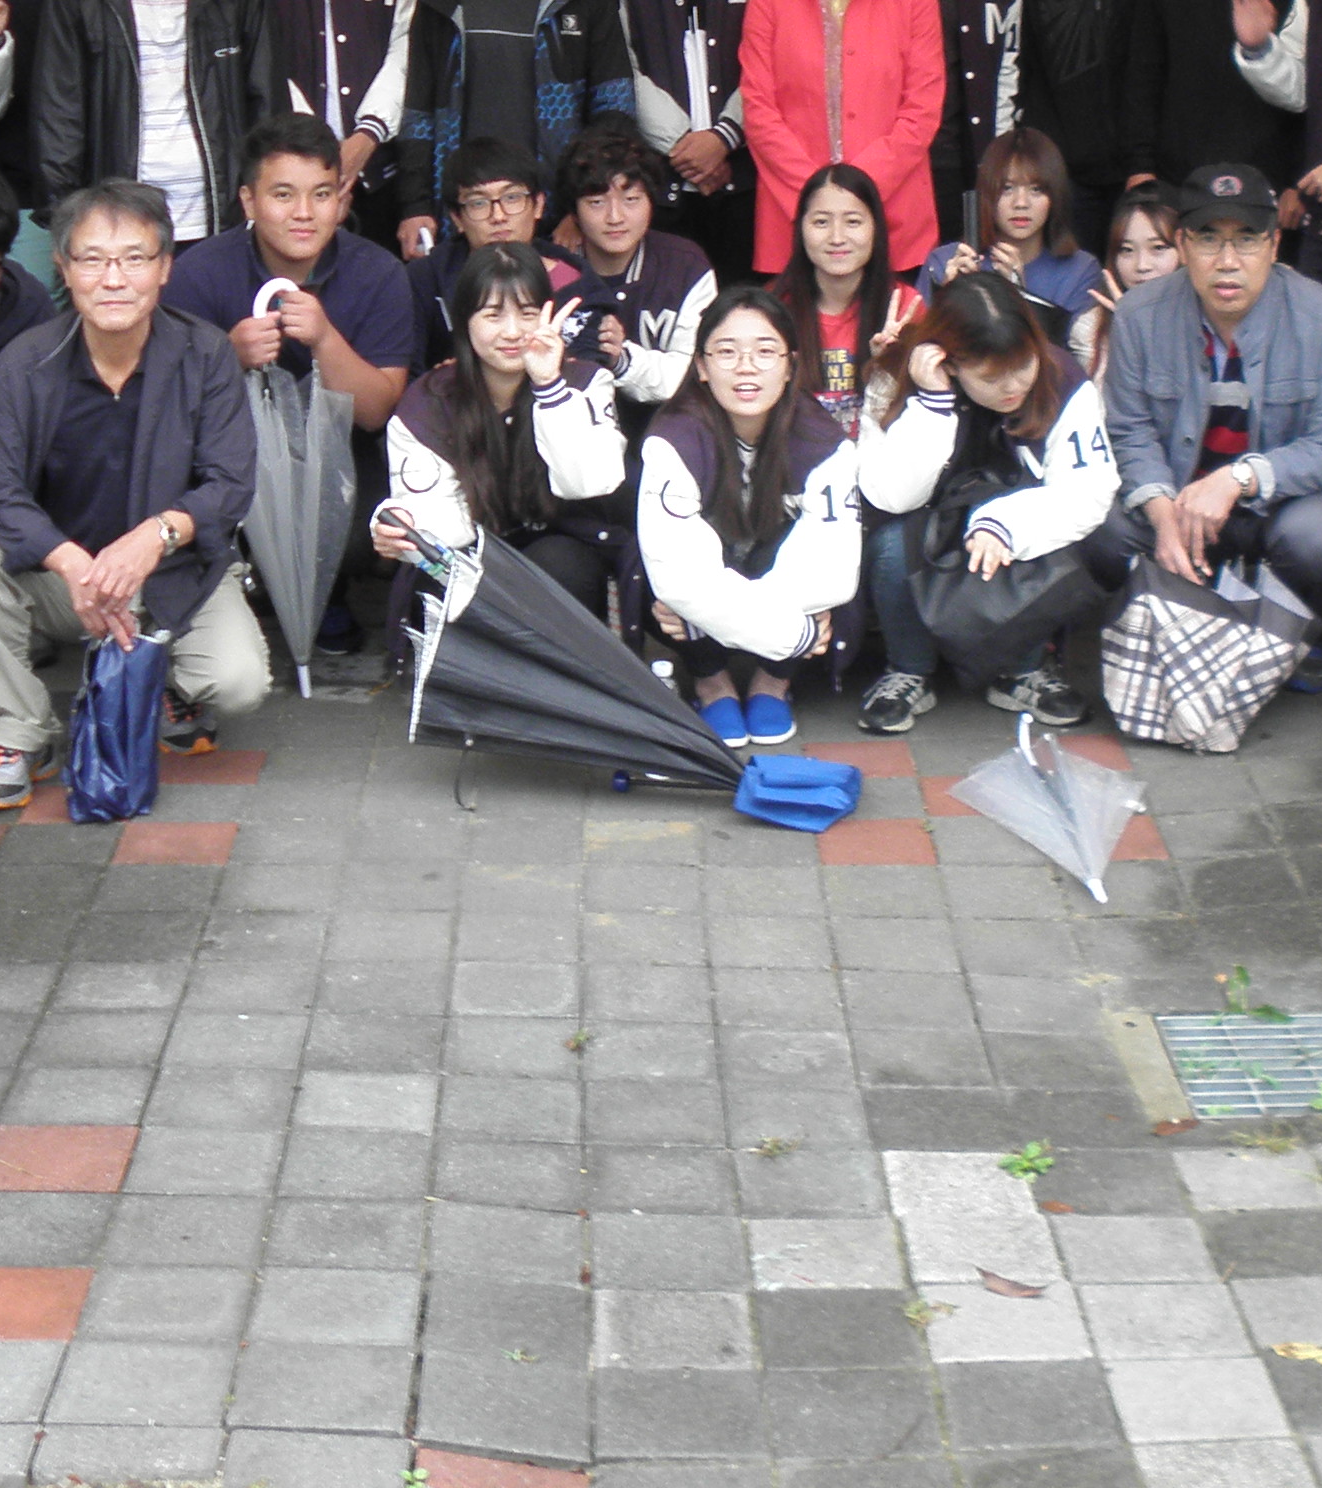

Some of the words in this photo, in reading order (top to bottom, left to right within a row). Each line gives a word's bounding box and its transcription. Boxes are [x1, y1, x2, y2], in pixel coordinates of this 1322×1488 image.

[639, 308, 677, 351] M
[1068, 426, 1110, 469] 14
[820, 485, 862, 523] 14
